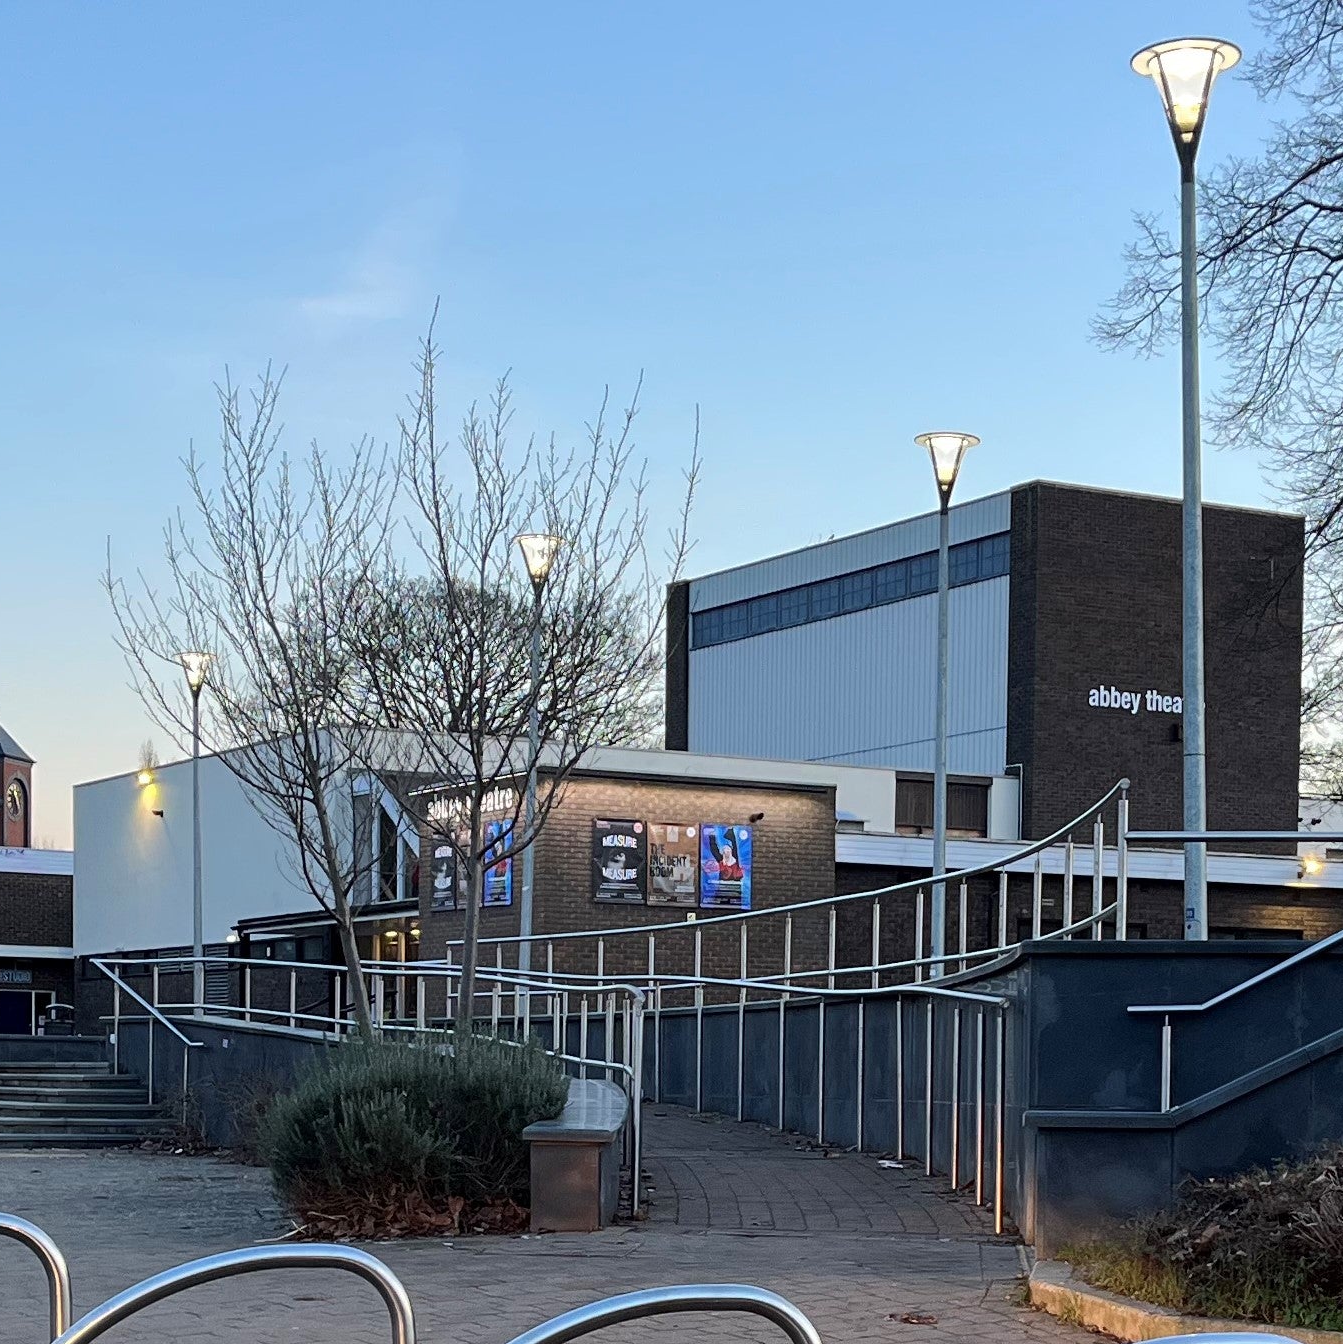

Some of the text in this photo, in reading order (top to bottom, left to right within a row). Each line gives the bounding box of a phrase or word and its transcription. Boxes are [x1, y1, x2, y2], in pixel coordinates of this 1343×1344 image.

[1088, 685, 1205, 714] abbey thea
[602, 834, 638, 849] MEASURE
[602, 867, 638, 881] MEASURE
